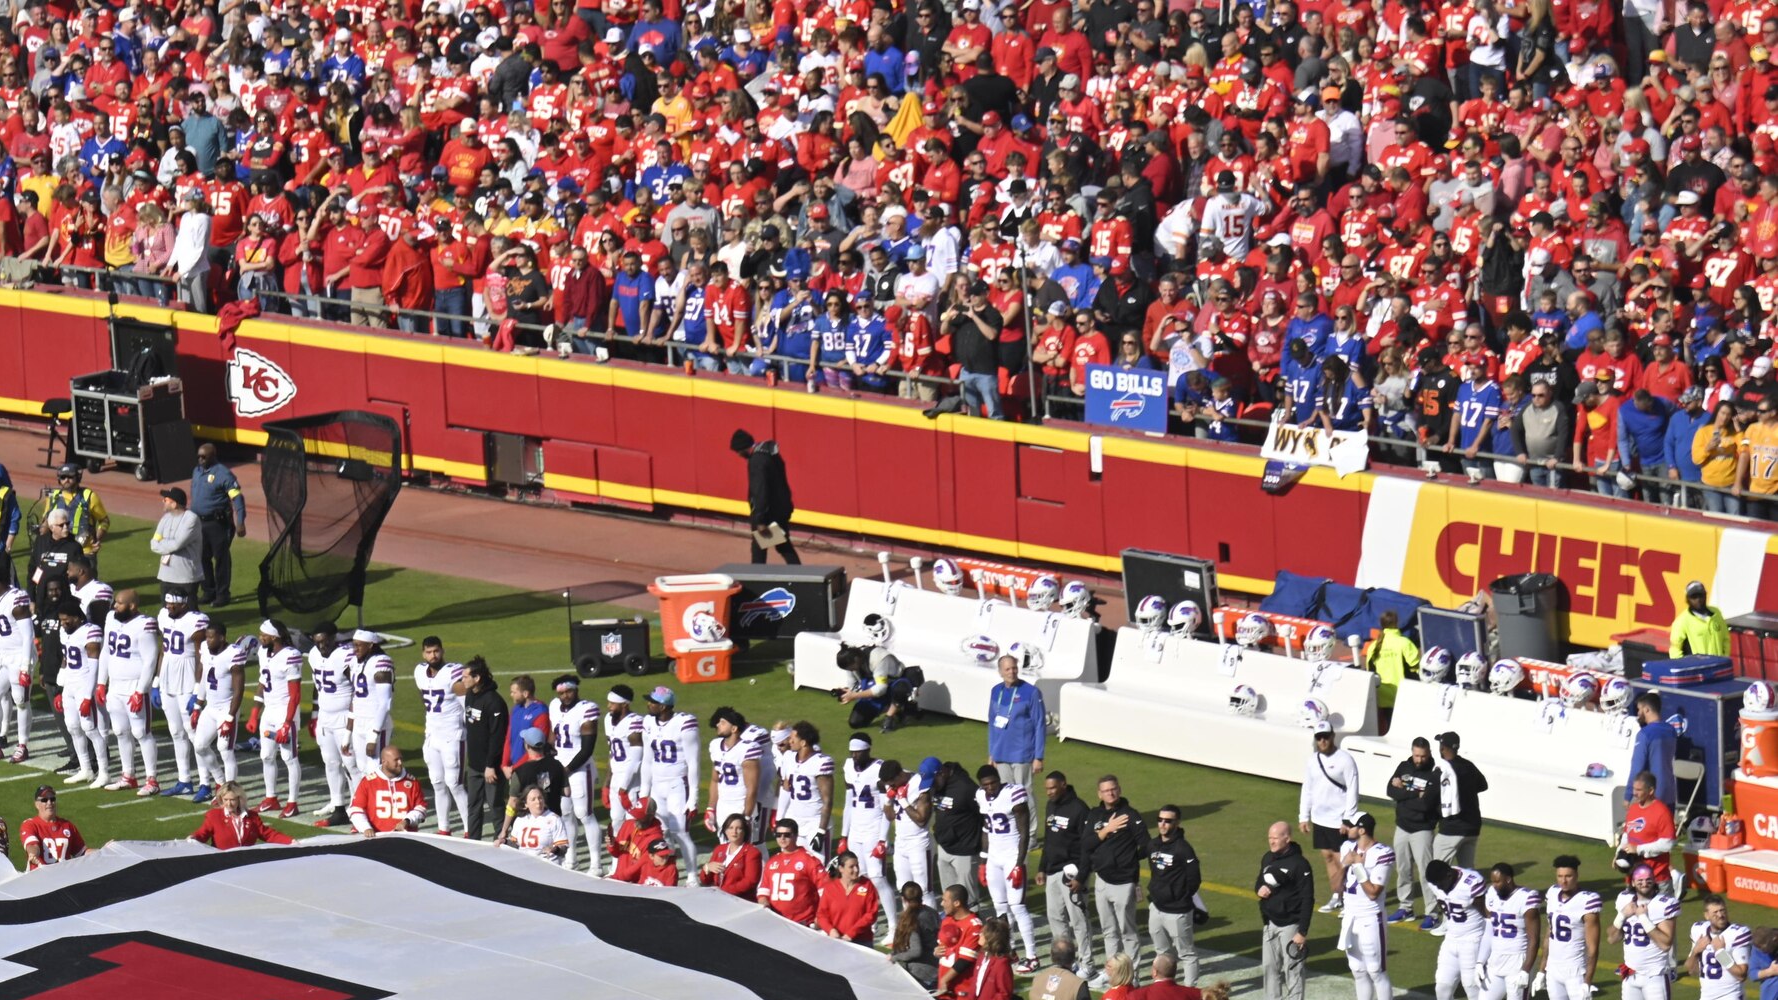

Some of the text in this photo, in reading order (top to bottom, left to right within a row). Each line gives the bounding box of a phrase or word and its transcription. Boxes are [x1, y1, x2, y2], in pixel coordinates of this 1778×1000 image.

[1445, 15, 1463, 32] 15
[1741, 10, 1763, 35] 15
[532, 94, 556, 118] 95
[109, 116, 129, 141] 15
[210, 192, 231, 215] 15
[1223, 216, 1244, 237] 15
[1095, 235, 1110, 256] 15
[1453, 227, 1472, 252] 15
[685, 298, 704, 321] 27
[712, 302, 733, 325] 14
[824, 331, 845, 351] 88
[1090, 370, 1163, 397] GO BILLS
[1292, 380, 1309, 403] 17
[1461, 401, 1482, 427] 17
[1752, 454, 1778, 479] 17
[1435, 520, 1681, 626] CHIEFS
[108, 631, 131, 659] 92
[697, 656, 717, 677] G
[207, 667, 218, 691] 4
[376, 791, 408, 820] 52
[520, 827, 541, 848] 15
[43, 837, 69, 864] 87
[771, 873, 795, 901] 15
[1491, 914, 1517, 938] 25
[1547, 915, 1572, 943] 16
